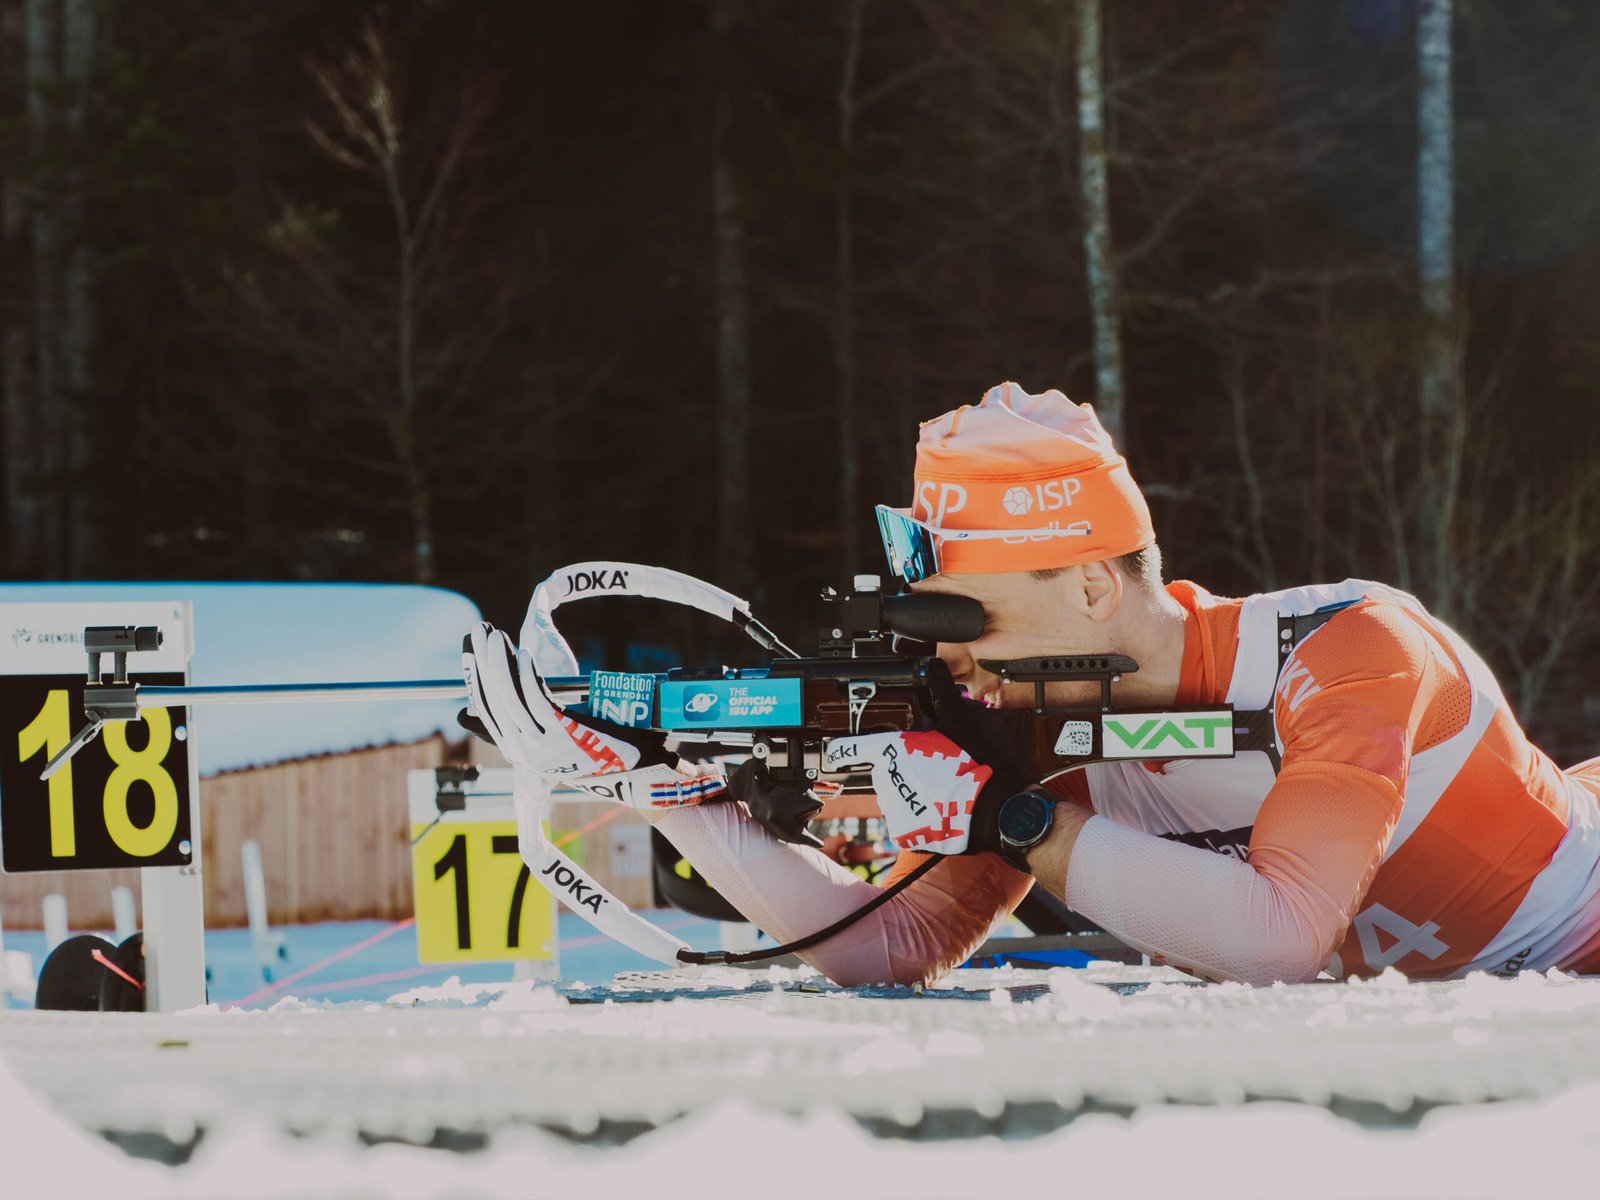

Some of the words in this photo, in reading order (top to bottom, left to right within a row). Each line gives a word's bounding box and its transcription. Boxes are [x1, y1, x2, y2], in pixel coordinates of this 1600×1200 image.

[1036, 477, 1081, 512] ISP
[565, 570, 628, 597] JOKA
[595, 674, 651, 691] Fondation
[603, 689, 650, 700] GRENOBLE
[729, 687, 749, 697] THE
[592, 697, 649, 727] INP
[729, 696, 778, 706] OFFICIAL
[729, 706, 749, 715] IBU
[750, 706, 774, 715] APP
[1104, 717, 1232, 750] VAT
[18, 690, 178, 857] 18
[434, 834, 530, 949] 17
[542, 859, 606, 914] JOKA
